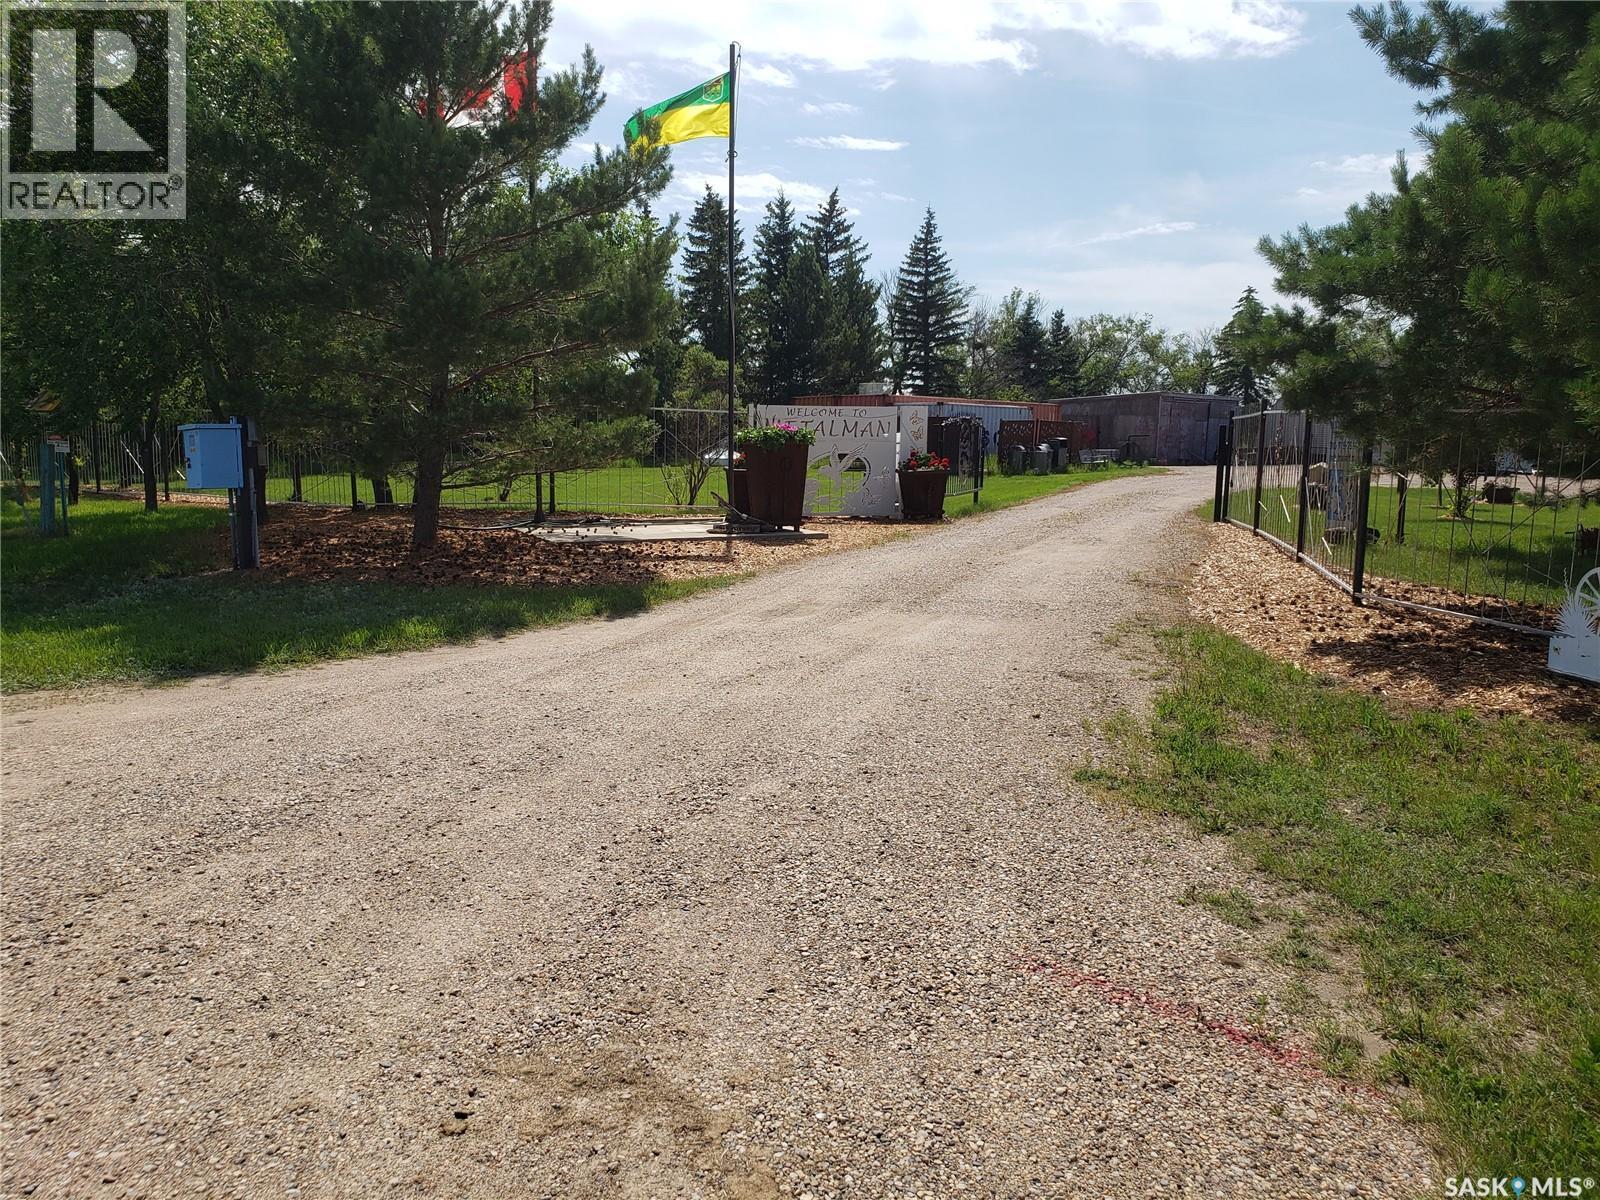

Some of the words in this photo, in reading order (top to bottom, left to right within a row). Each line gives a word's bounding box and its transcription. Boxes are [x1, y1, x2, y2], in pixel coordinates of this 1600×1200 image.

[786, 407, 843, 418] WELCOME
[853, 408, 867, 418] TO
[766, 413, 891, 438] TALMAN
